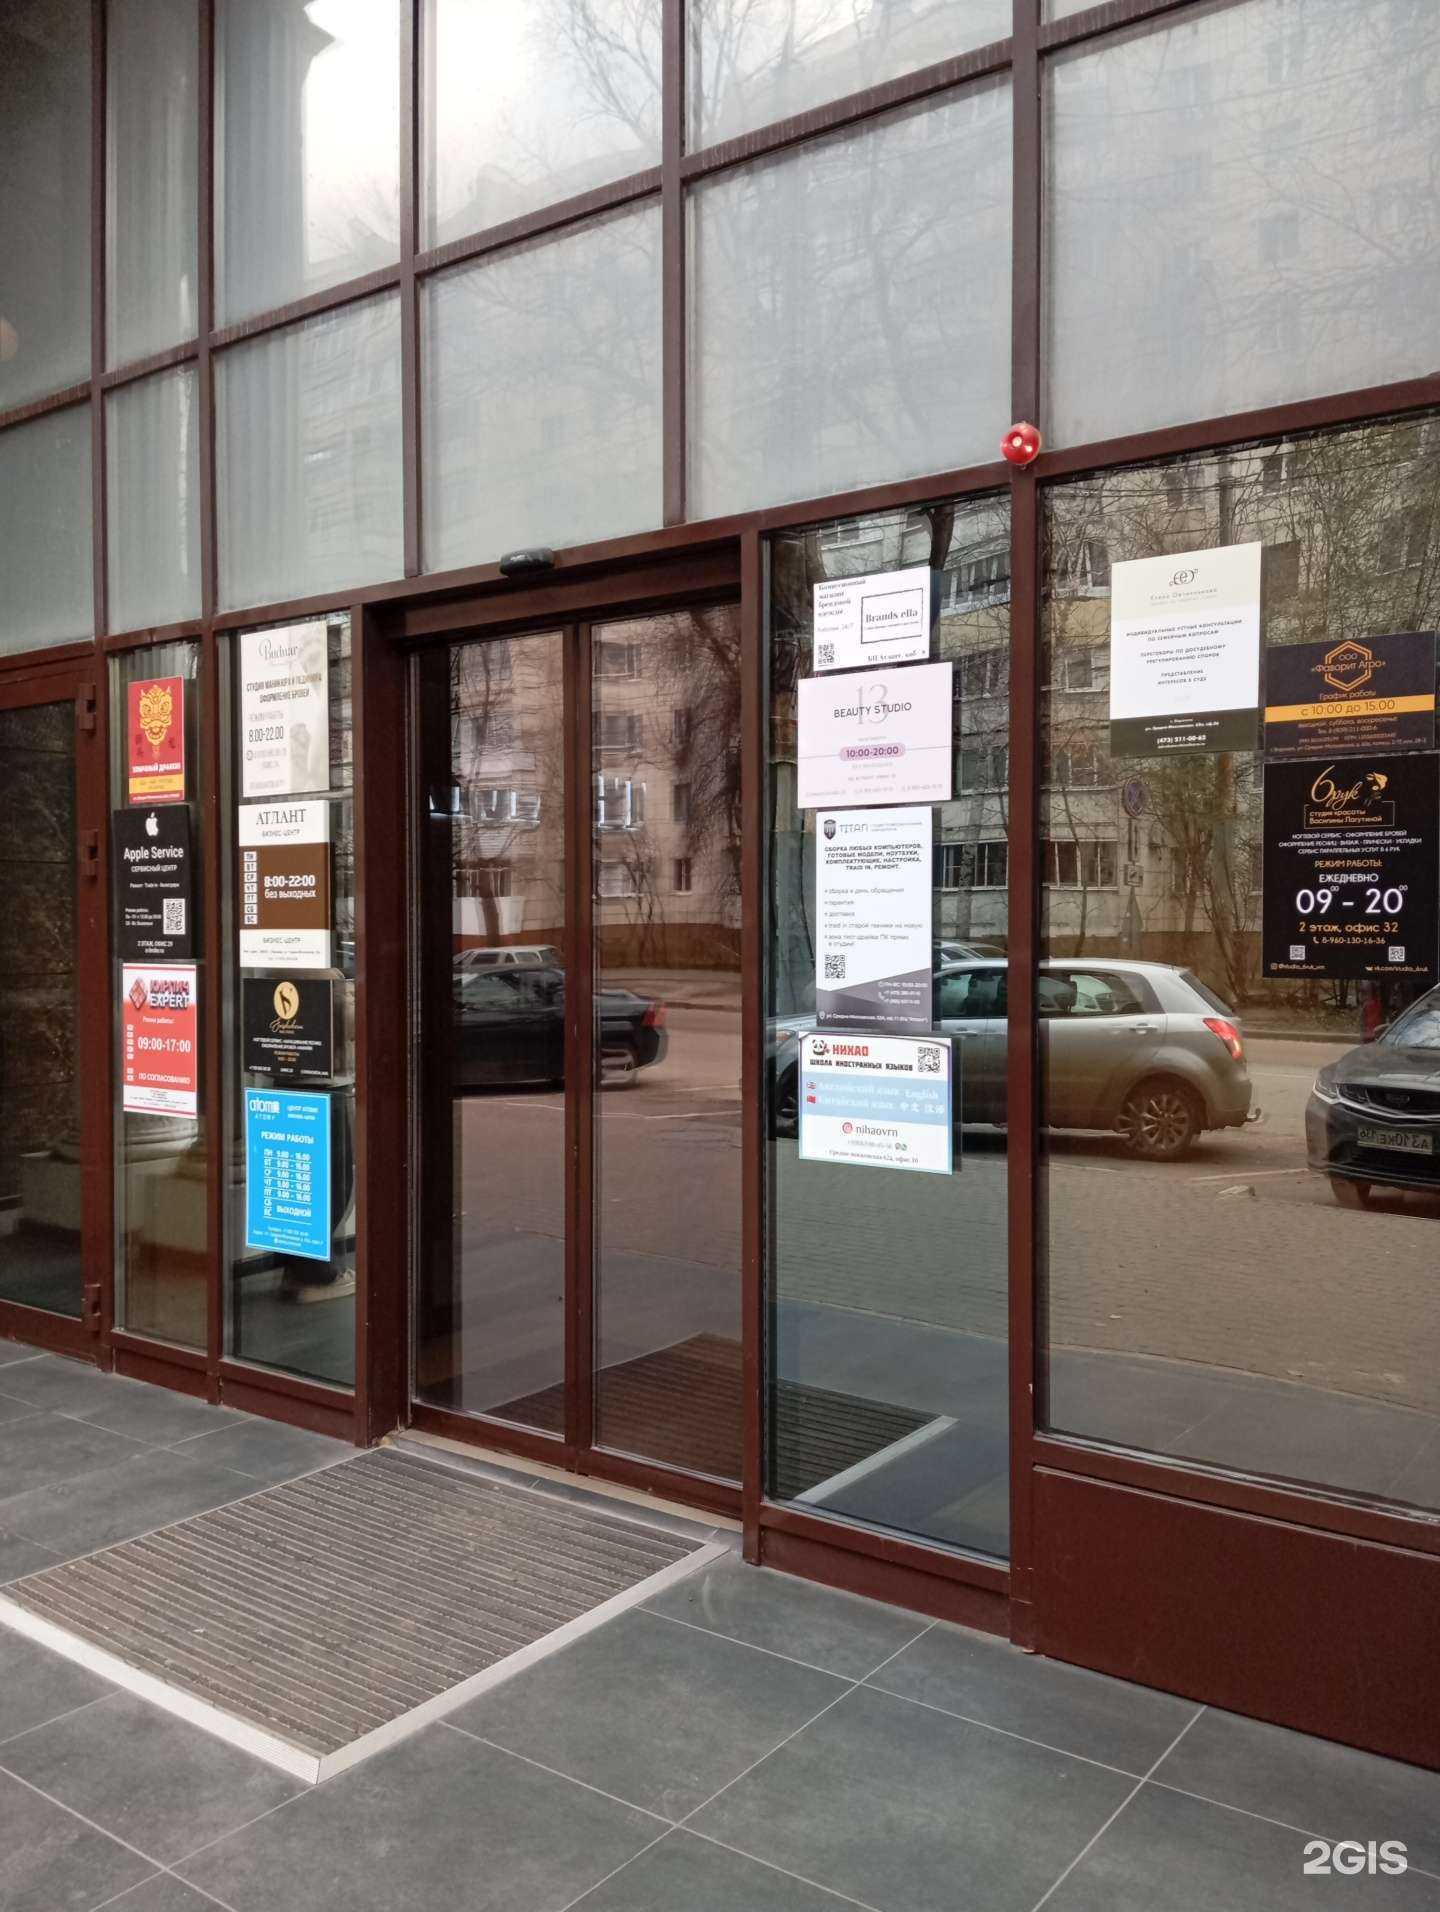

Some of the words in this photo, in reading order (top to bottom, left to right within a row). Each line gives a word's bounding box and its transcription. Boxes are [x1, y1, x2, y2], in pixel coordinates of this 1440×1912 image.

[866, 611, 898, 623] Brands
[1338, 653, 1358, 661] ООО
[834, 706, 872, 719] BEAUTY
[875, 702, 913, 715] STUDIO
[856, 684, 889, 725] 13
[1345, 706, 1361, 715] до
[847, 746, 899, 759] 10:00-20:00
[256, 809, 307, 825] АТЛАНТ
[124, 846, 150, 862] Apple
[151, 845, 184, 859] Service
[131, 864, 161, 873] СЕРВИСНЫЙ
[1314, 860, 1346, 869] РЕЖИМ
[1347, 859, 1383, 868] РАБОТЫ:
[264, 875, 316, 888] 8:00-22:00
[1319, 874, 1379, 885] ЕЖЕДНЕВНО
[1296, 889, 1333, 914] 09
[1365, 888, 1403, 914] 20
[1299, 922, 1305, 933] 2
[1310, 924, 1342, 934] этаж,
[1345, 922, 1380, 934] офис
[1384, 922, 1399, 933] 32
[150, 995, 190, 1010] EXPERT
[138, 1036, 192, 1053] 09:00-17:00
[833, 1044, 869, 1057] НИХАО
[810, 1059, 833, 1067] ШКОЛА
[836, 1060, 882, 1070] ИНОСТРАННЫХ
[886, 1063, 914, 1072] ЯЗЫКОВ
[856, 1124, 898, 1138] nihaovrn
[287, 1132, 314, 1145] РАБОТЫ
